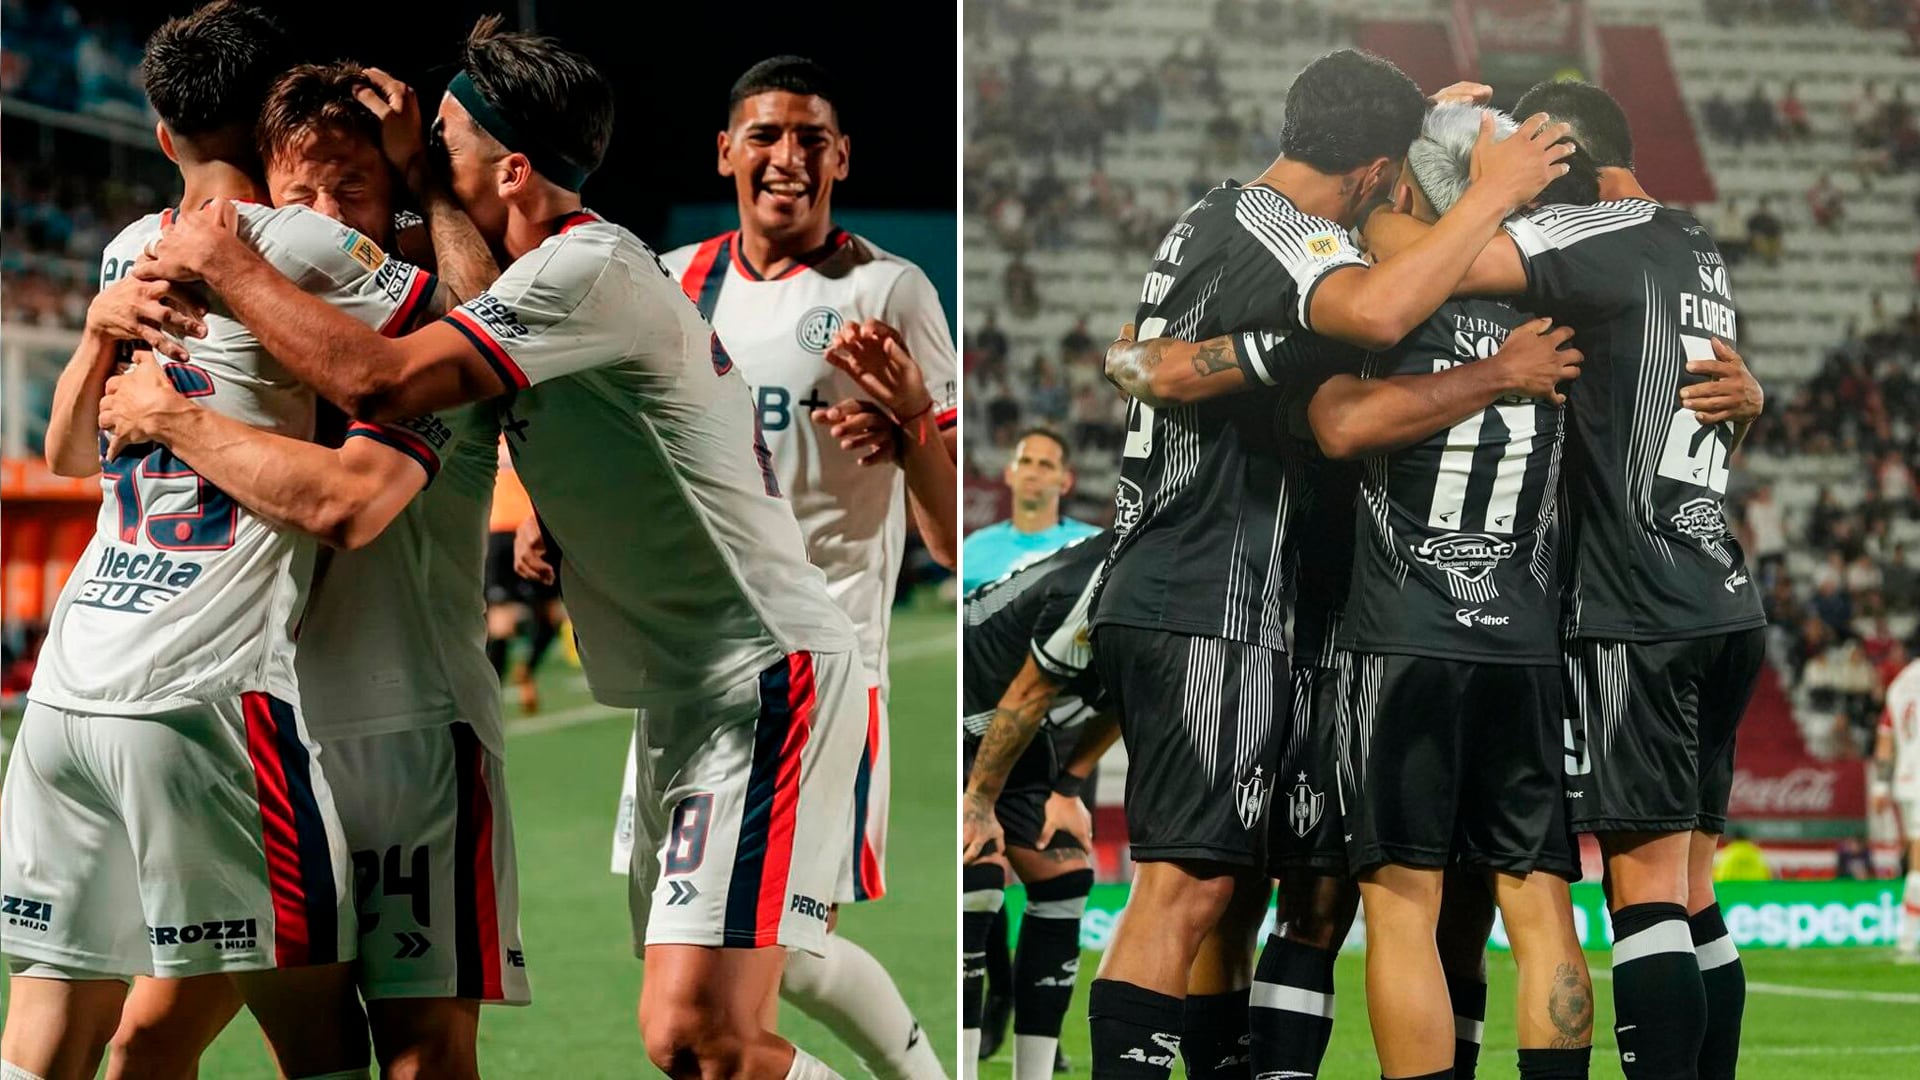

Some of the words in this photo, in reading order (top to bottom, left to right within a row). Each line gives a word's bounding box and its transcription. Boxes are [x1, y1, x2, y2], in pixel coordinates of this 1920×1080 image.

[1453, 314, 1511, 342] TARJET
[1454, 330, 1499, 360] SO
[73, 579, 181, 615] BUS
[664, 791, 715, 878] 8
[20, 918, 48, 932] HIJO
